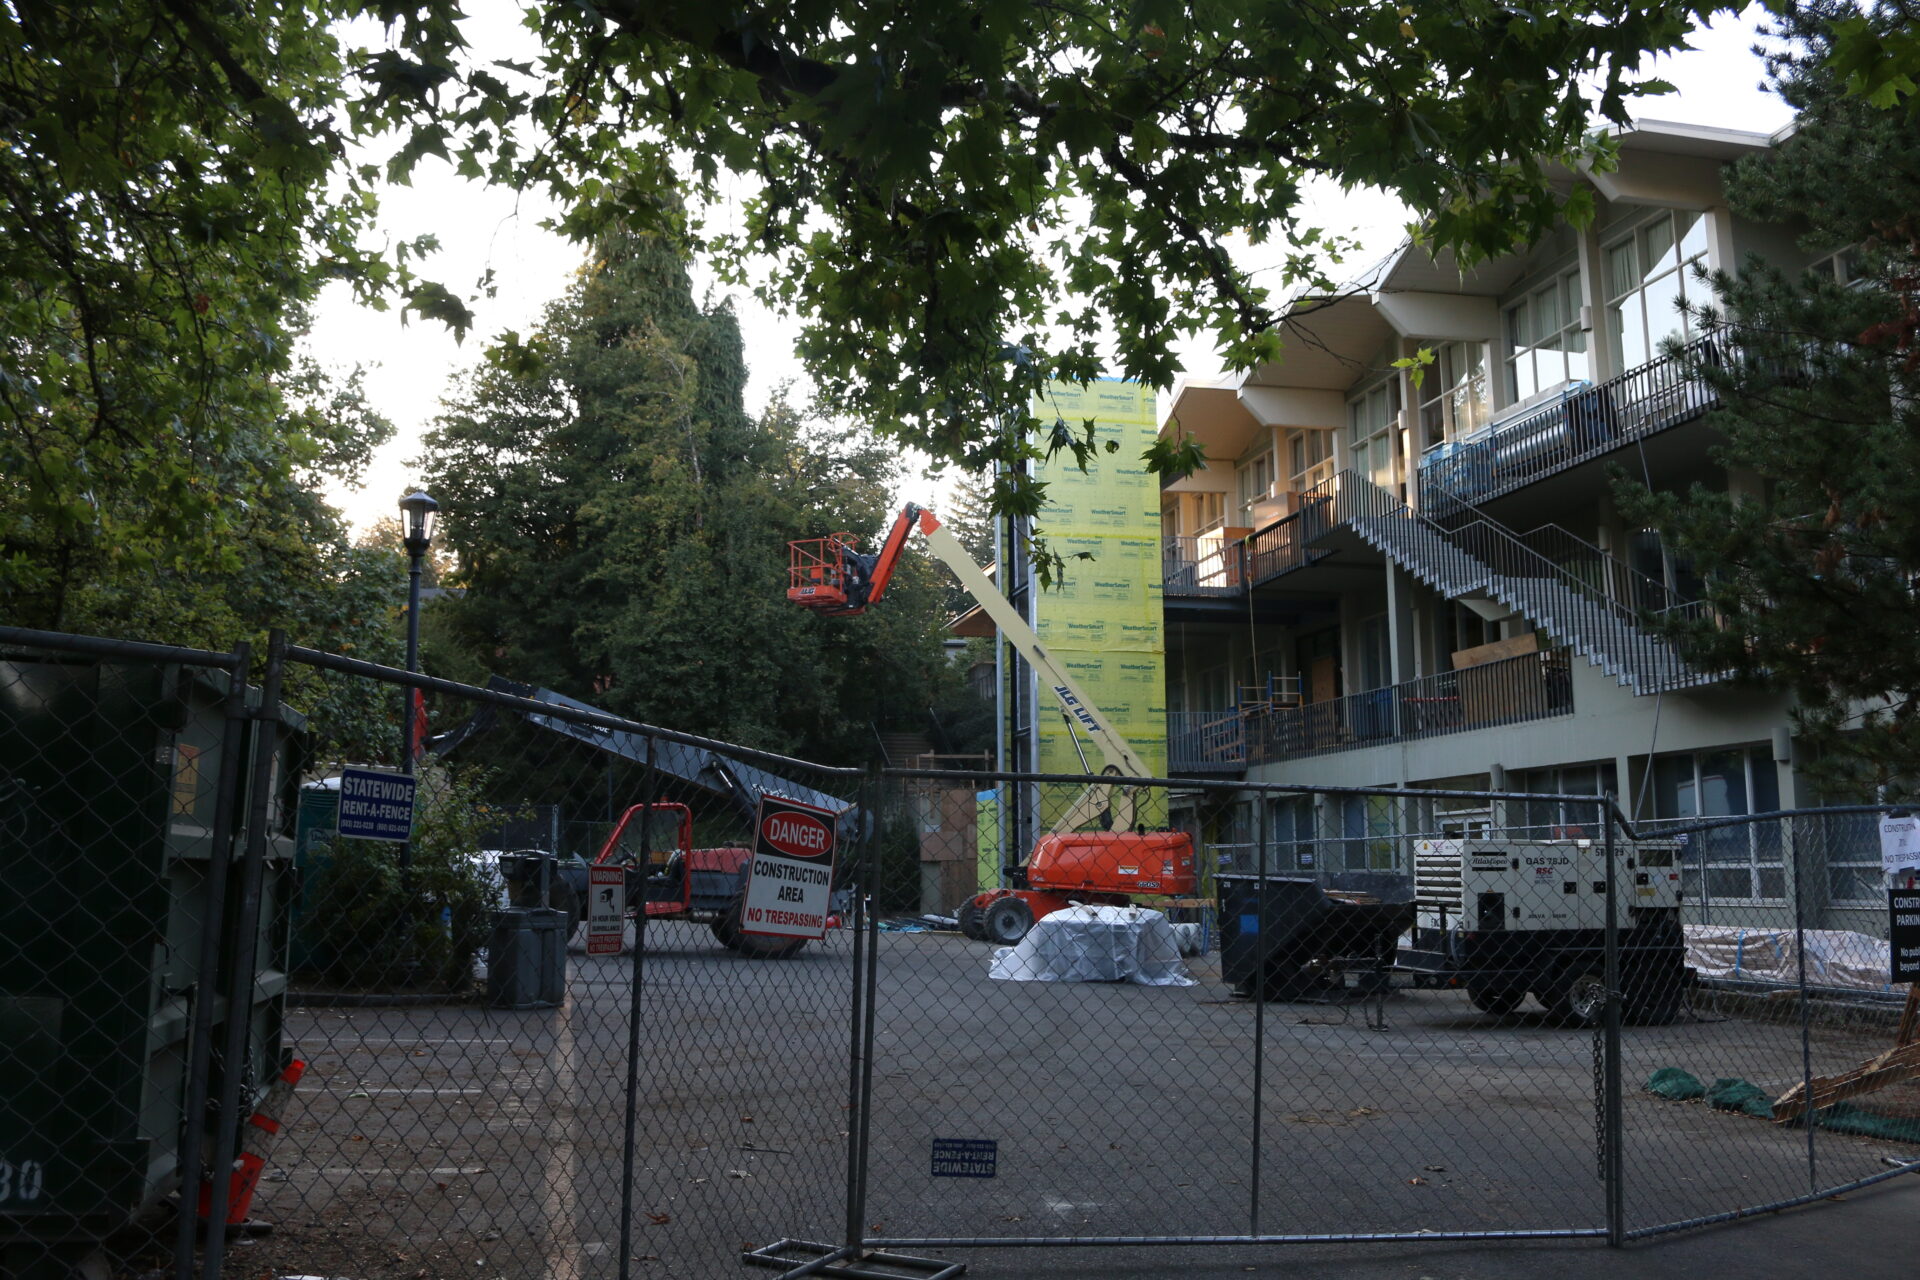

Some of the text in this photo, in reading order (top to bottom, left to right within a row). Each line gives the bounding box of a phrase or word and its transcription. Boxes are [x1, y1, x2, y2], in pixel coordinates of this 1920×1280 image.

[1054, 686, 1079, 706] JLG
[1073, 707, 1101, 732] LIFT
[343, 777, 414, 802] STATEWIDE
[769, 818, 825, 850] DANGER
[592, 870, 622, 883] WARNING
[754, 859, 830, 887] CONSTRUCTION
[777, 885, 804, 903] AREA
[747, 907, 823, 929] NO TRESPASSING
[933, 1161, 994, 1174] STATEWIDE
